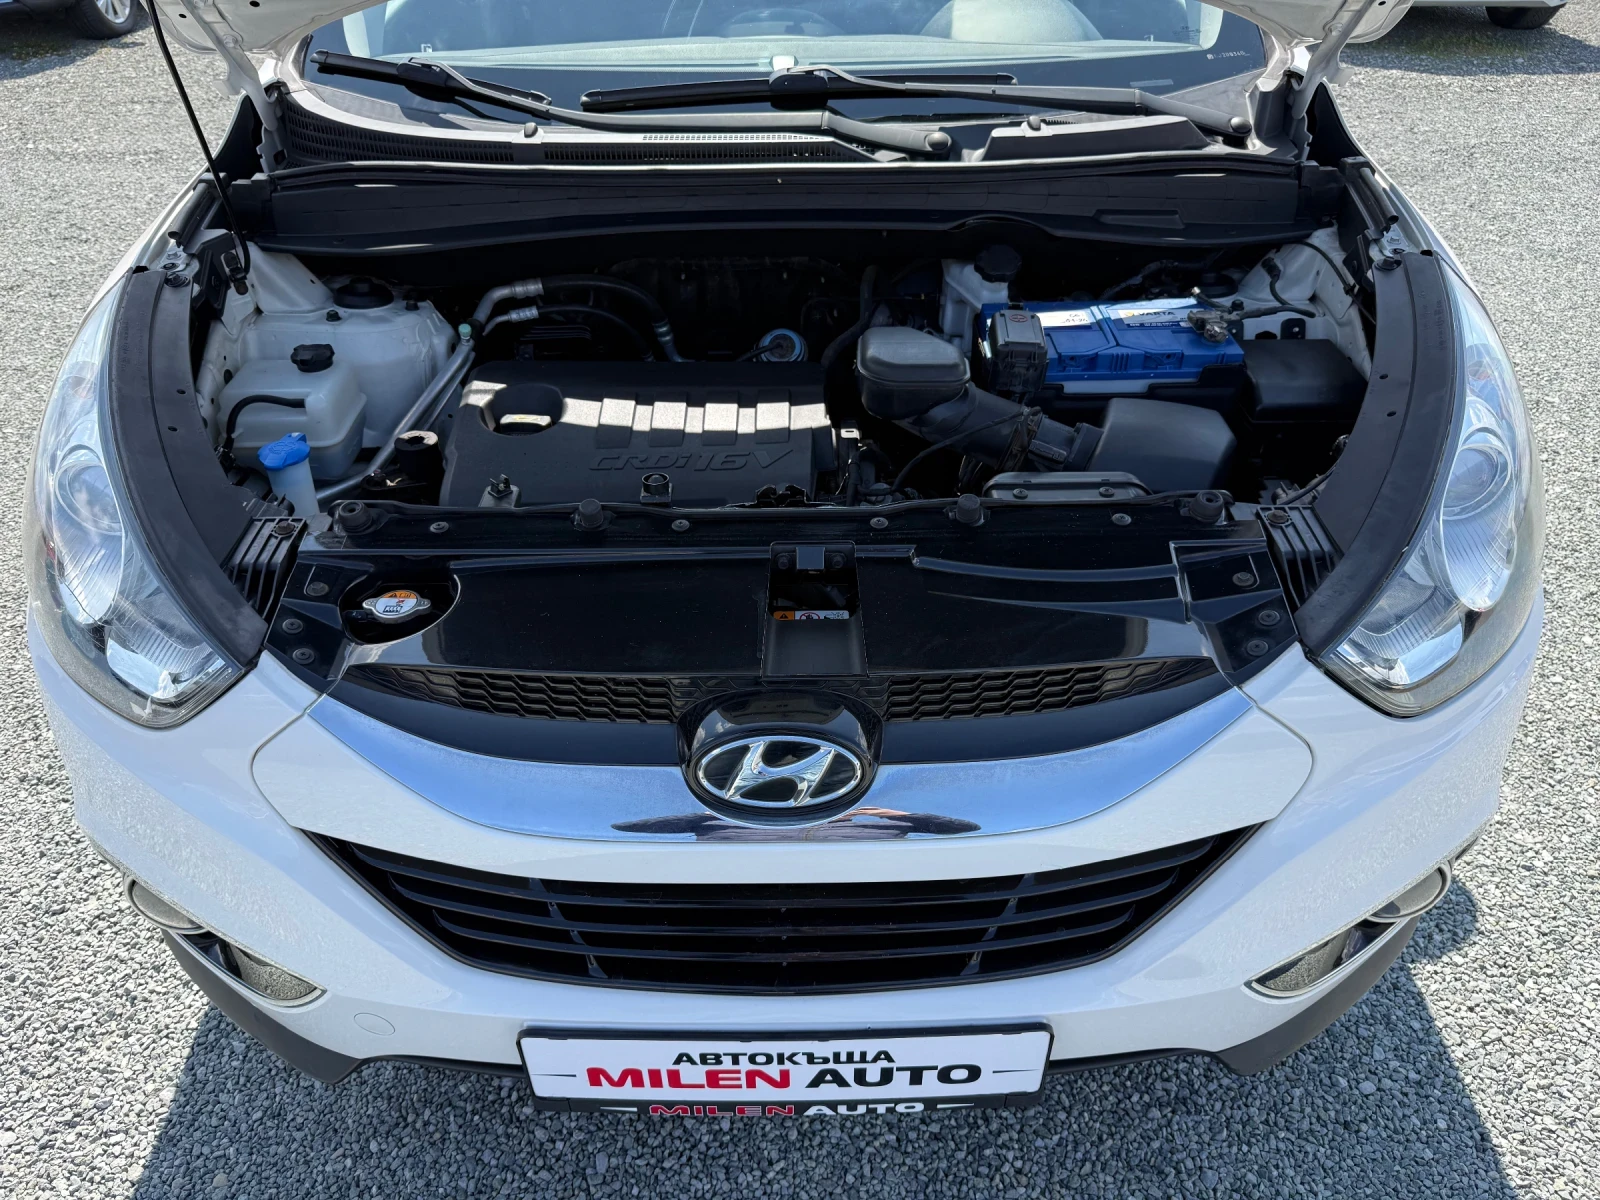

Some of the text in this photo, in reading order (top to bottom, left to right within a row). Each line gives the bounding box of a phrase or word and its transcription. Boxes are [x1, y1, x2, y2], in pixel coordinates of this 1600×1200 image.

[671, 1050, 896, 1066] АВТОКЪША
[586, 1063, 982, 1089] MILEN AUTO
[649, 1102, 925, 1116] MILEN AUTO
